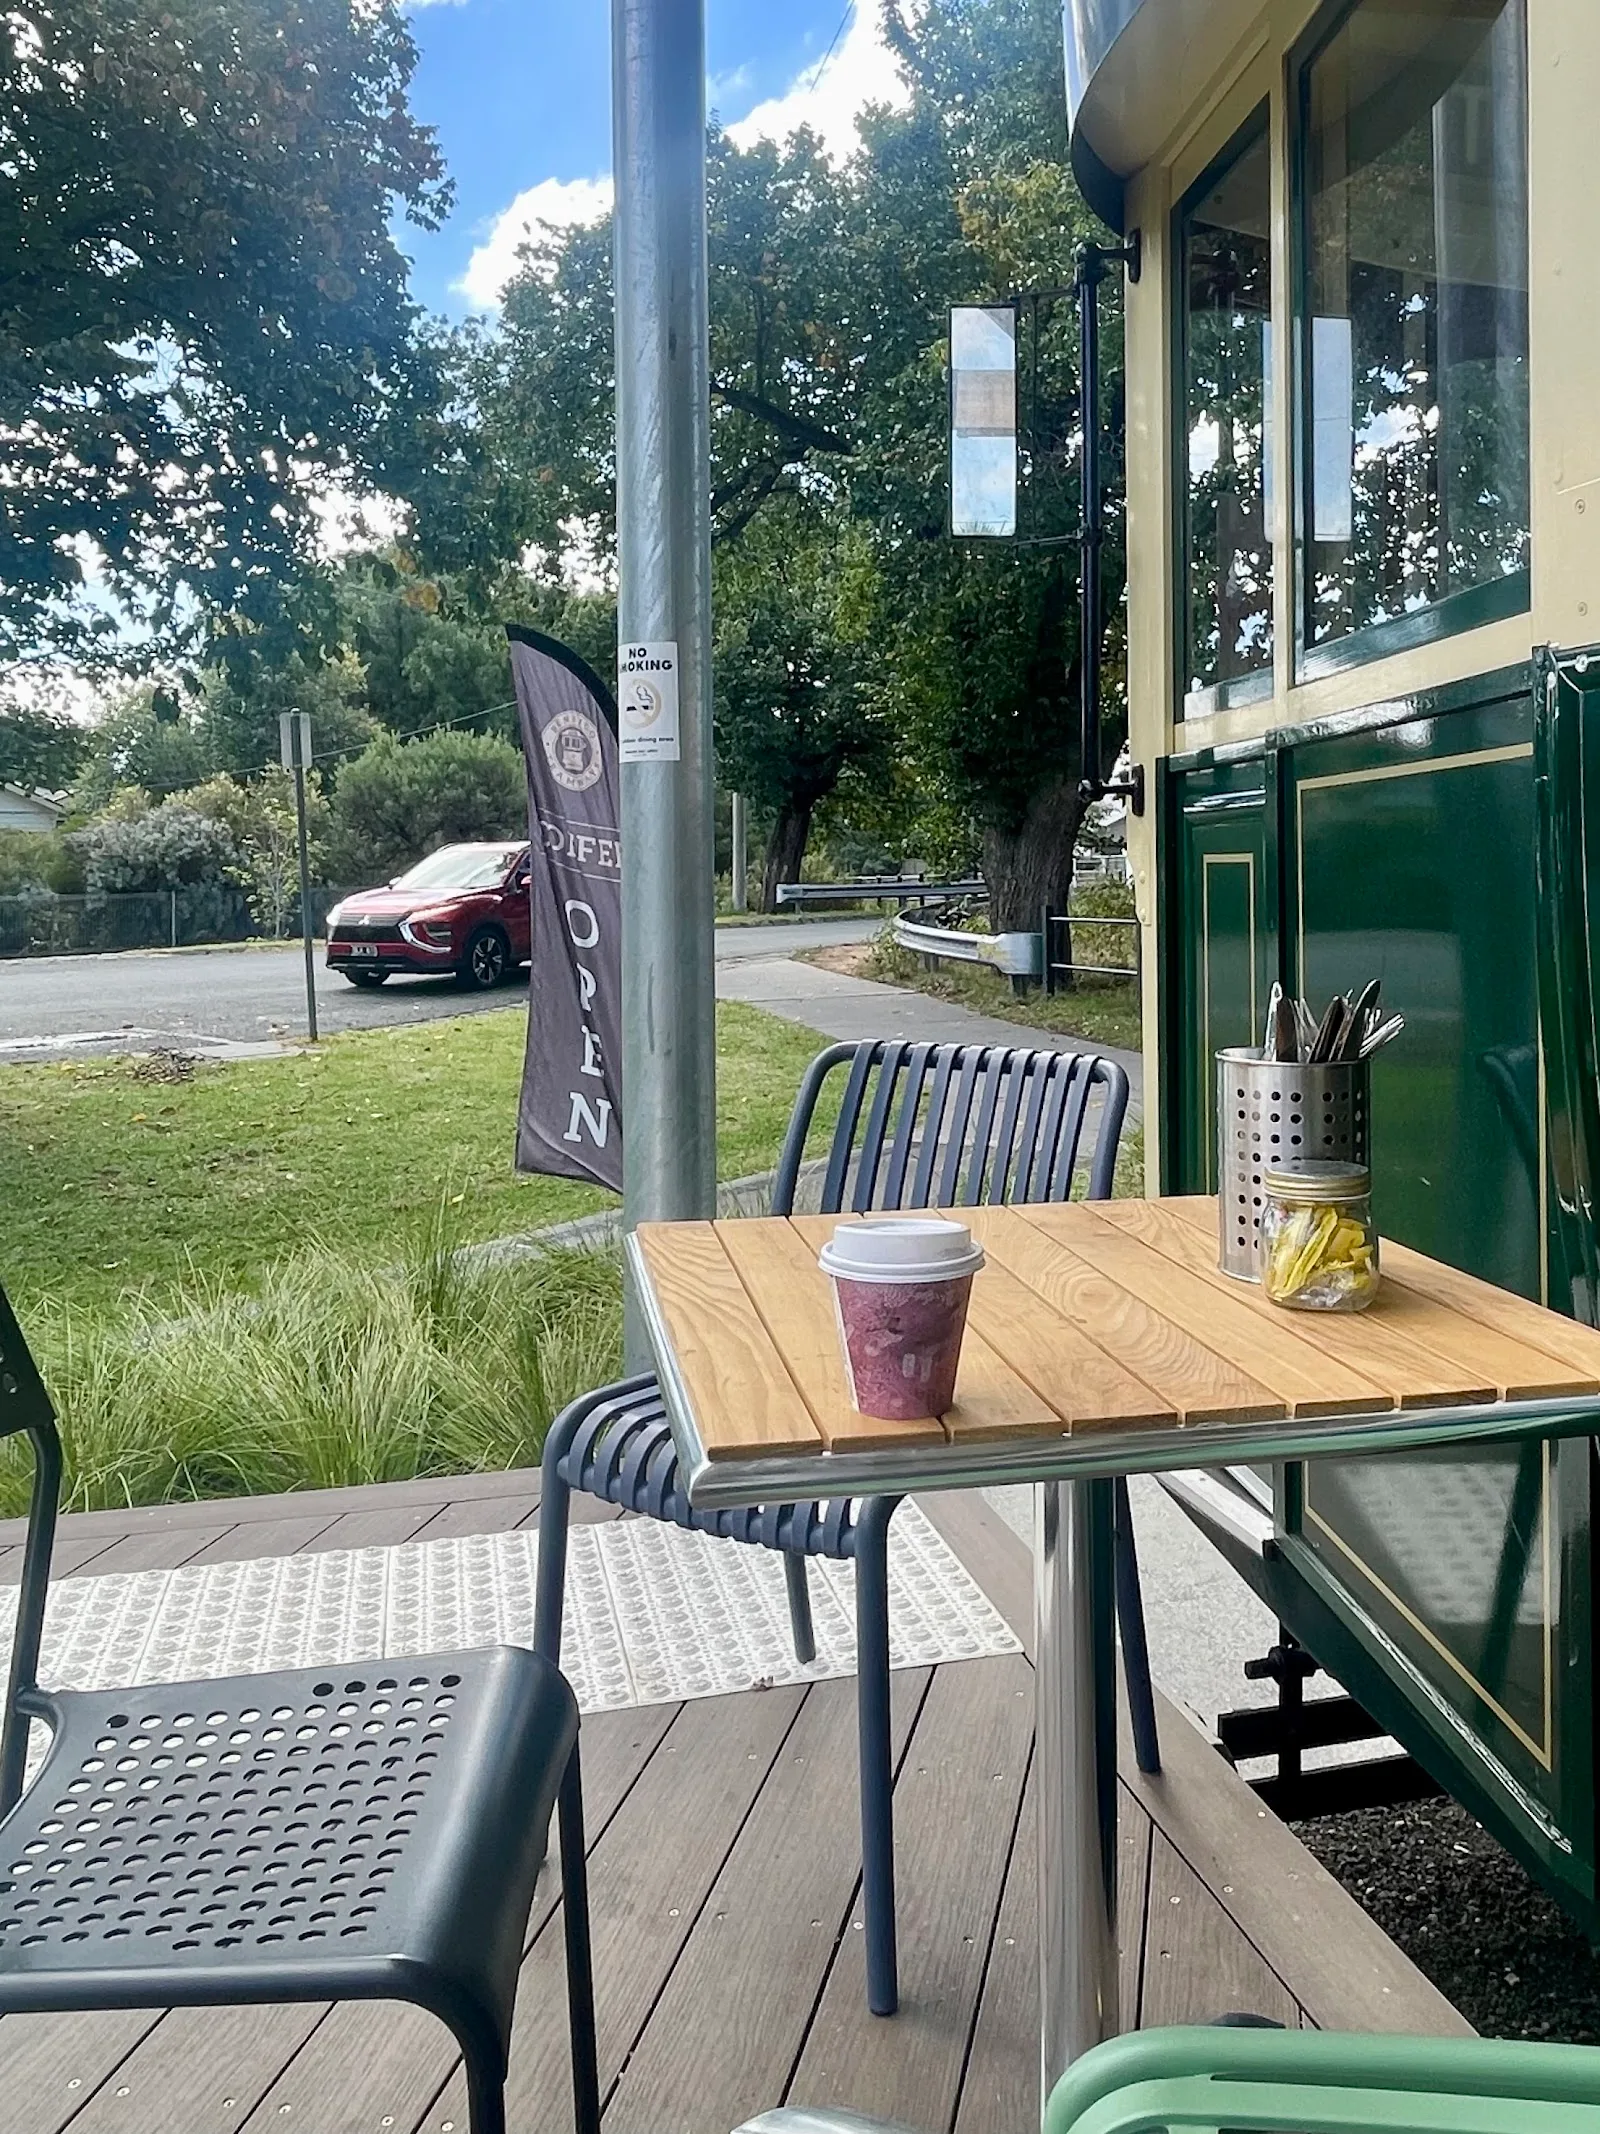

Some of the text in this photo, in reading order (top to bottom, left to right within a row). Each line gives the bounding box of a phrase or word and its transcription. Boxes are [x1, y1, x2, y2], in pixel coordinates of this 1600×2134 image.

[628, 647, 647, 659] NO
[620, 659, 673, 673] MOKING
[562, 899, 612, 1148] OPEN
